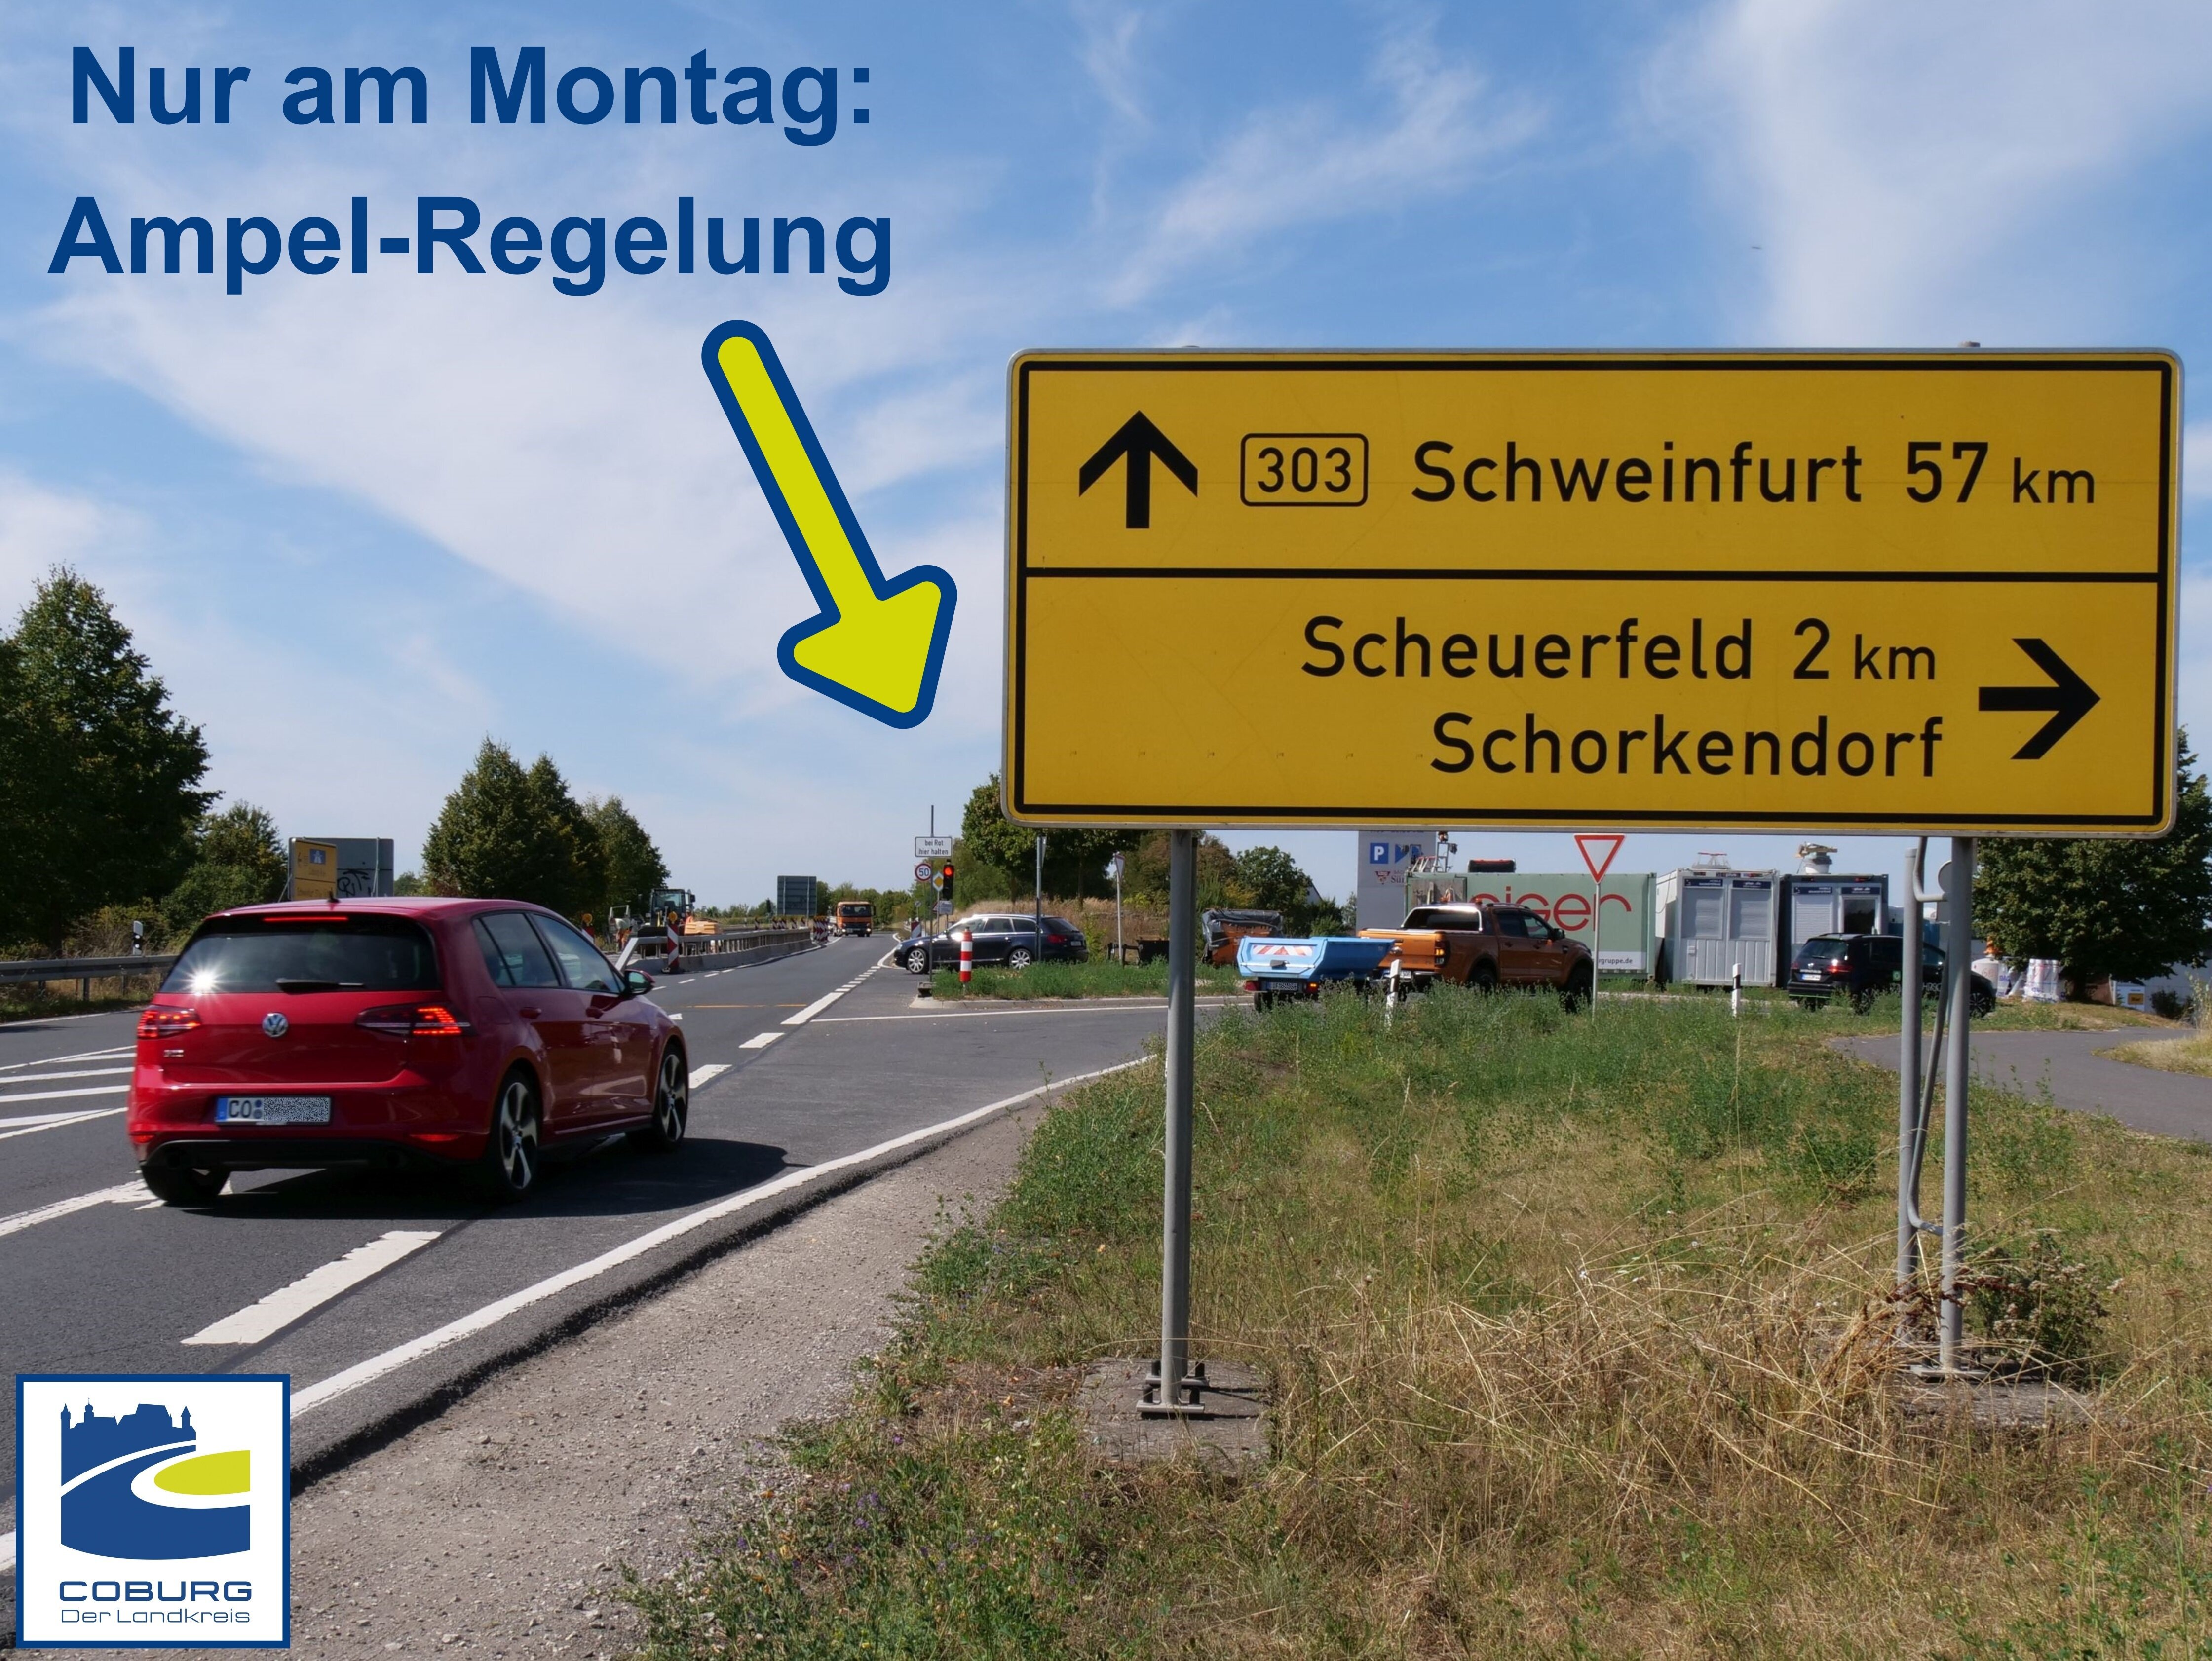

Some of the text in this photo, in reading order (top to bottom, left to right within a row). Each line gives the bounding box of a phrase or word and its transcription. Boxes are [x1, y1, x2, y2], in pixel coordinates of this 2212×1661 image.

[1257, 440, 2095, 504] 303 Schweinfurt 57 km
[1300, 615, 1936, 680] Scheuerfeld 2 km
[1430, 711, 1944, 778] Schorkendorf
[918, 868, 929, 877] 50
[1373, 846, 1385, 861] P
[229, 1100, 252, 1118] CO
